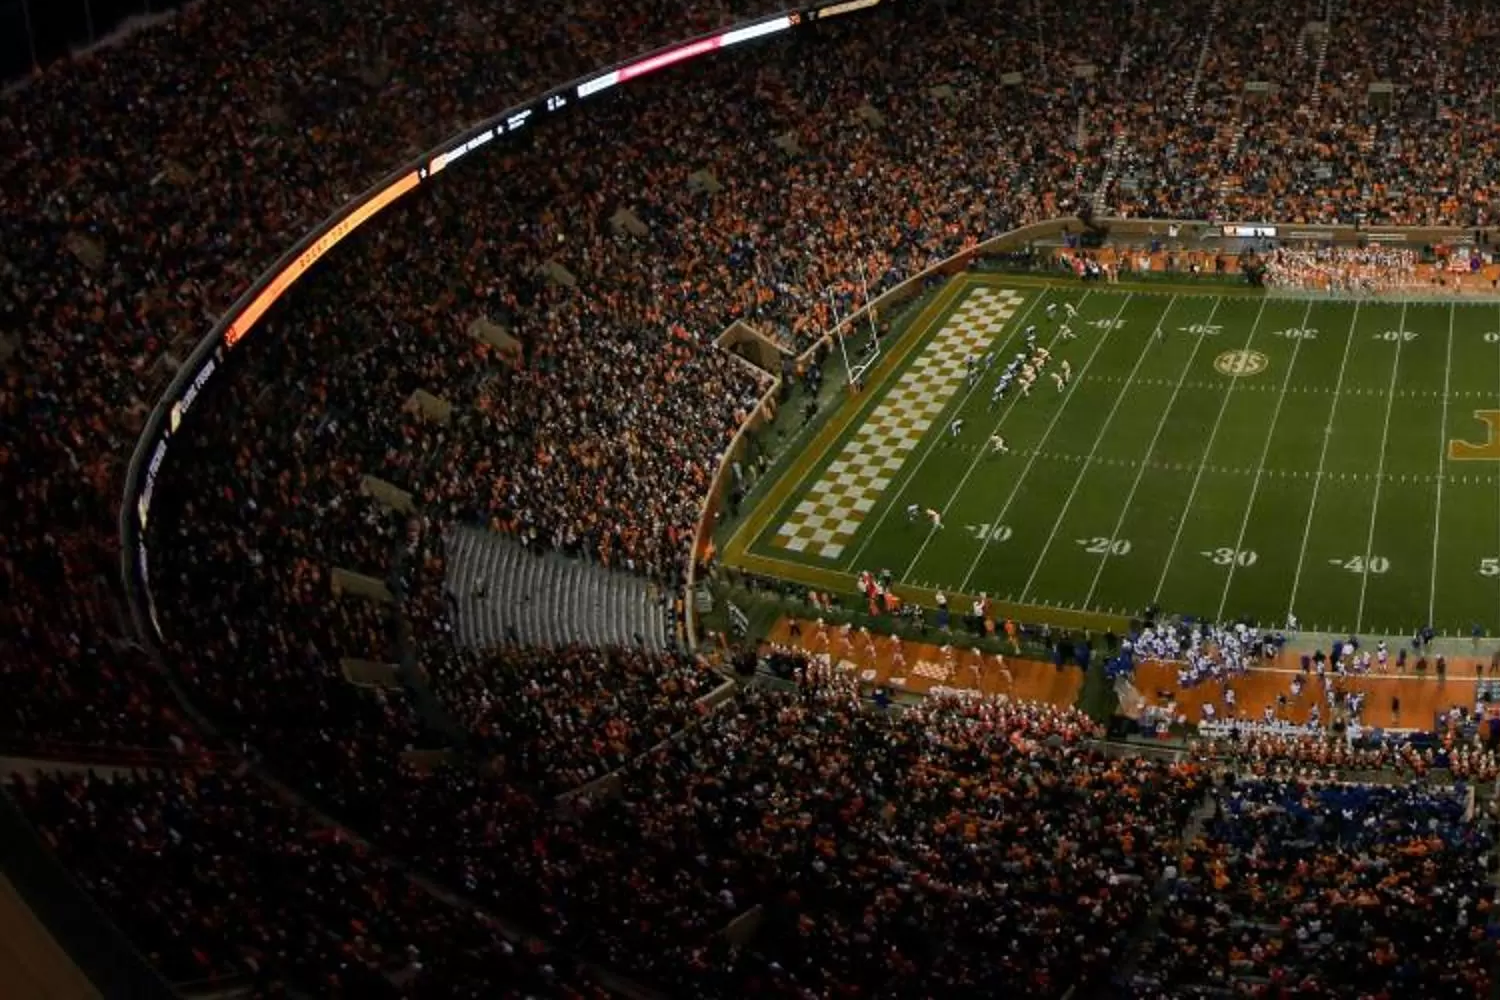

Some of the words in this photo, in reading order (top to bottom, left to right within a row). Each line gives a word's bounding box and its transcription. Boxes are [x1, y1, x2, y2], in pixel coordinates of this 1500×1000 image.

[975, 523, 1013, 541] 10
[1085, 537, 1132, 555] 20
[1213, 547, 1258, 566] 30
[1343, 556, 1390, 574] 40
